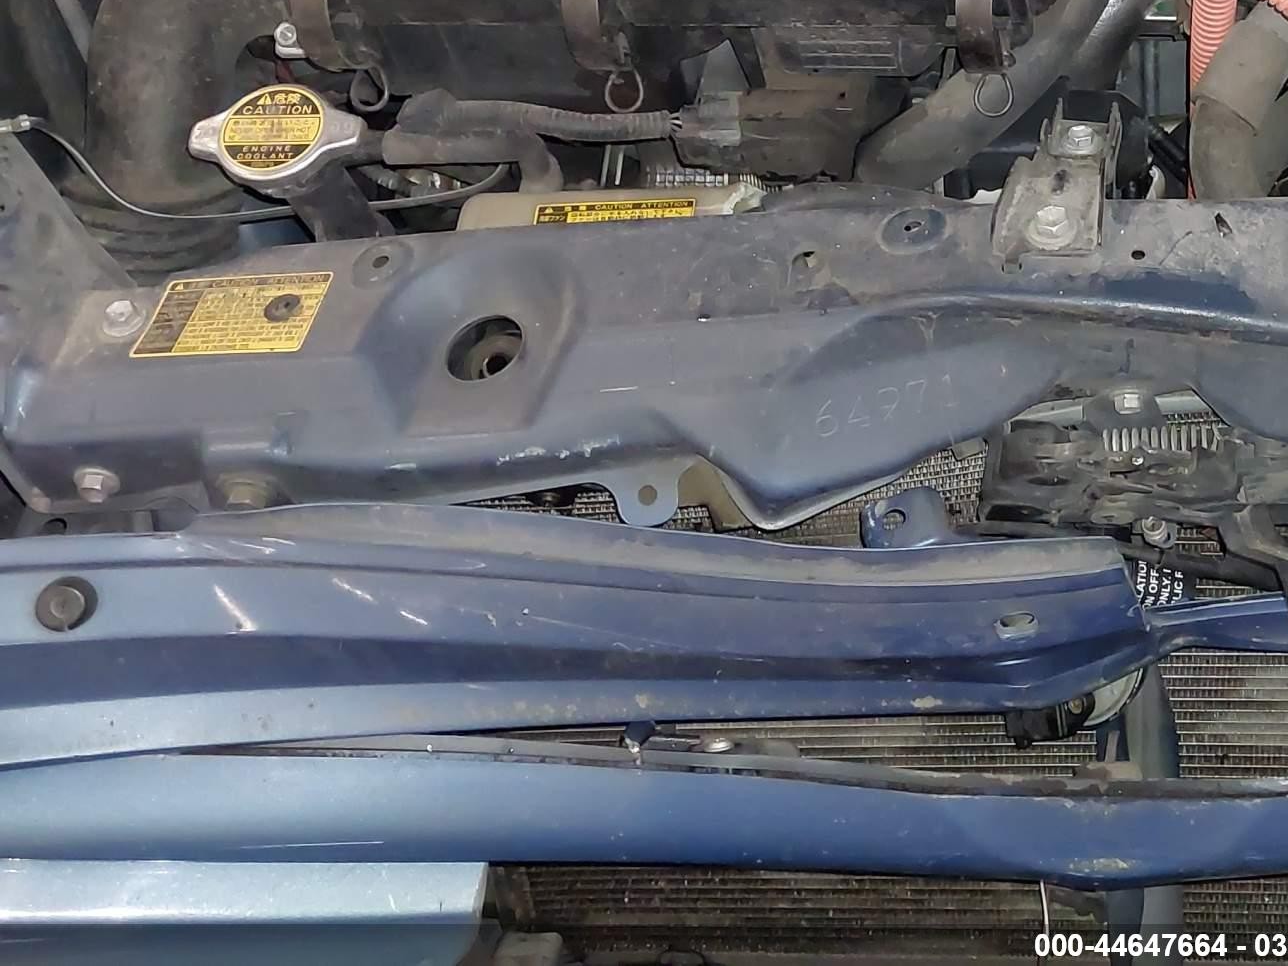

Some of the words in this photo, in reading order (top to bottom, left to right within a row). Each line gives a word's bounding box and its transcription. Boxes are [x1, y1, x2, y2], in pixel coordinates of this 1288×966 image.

[242, 105, 312, 115] CAUTION
[594, 202, 634, 211] CAUTION
[640, 201, 689, 209] ATTENTION
